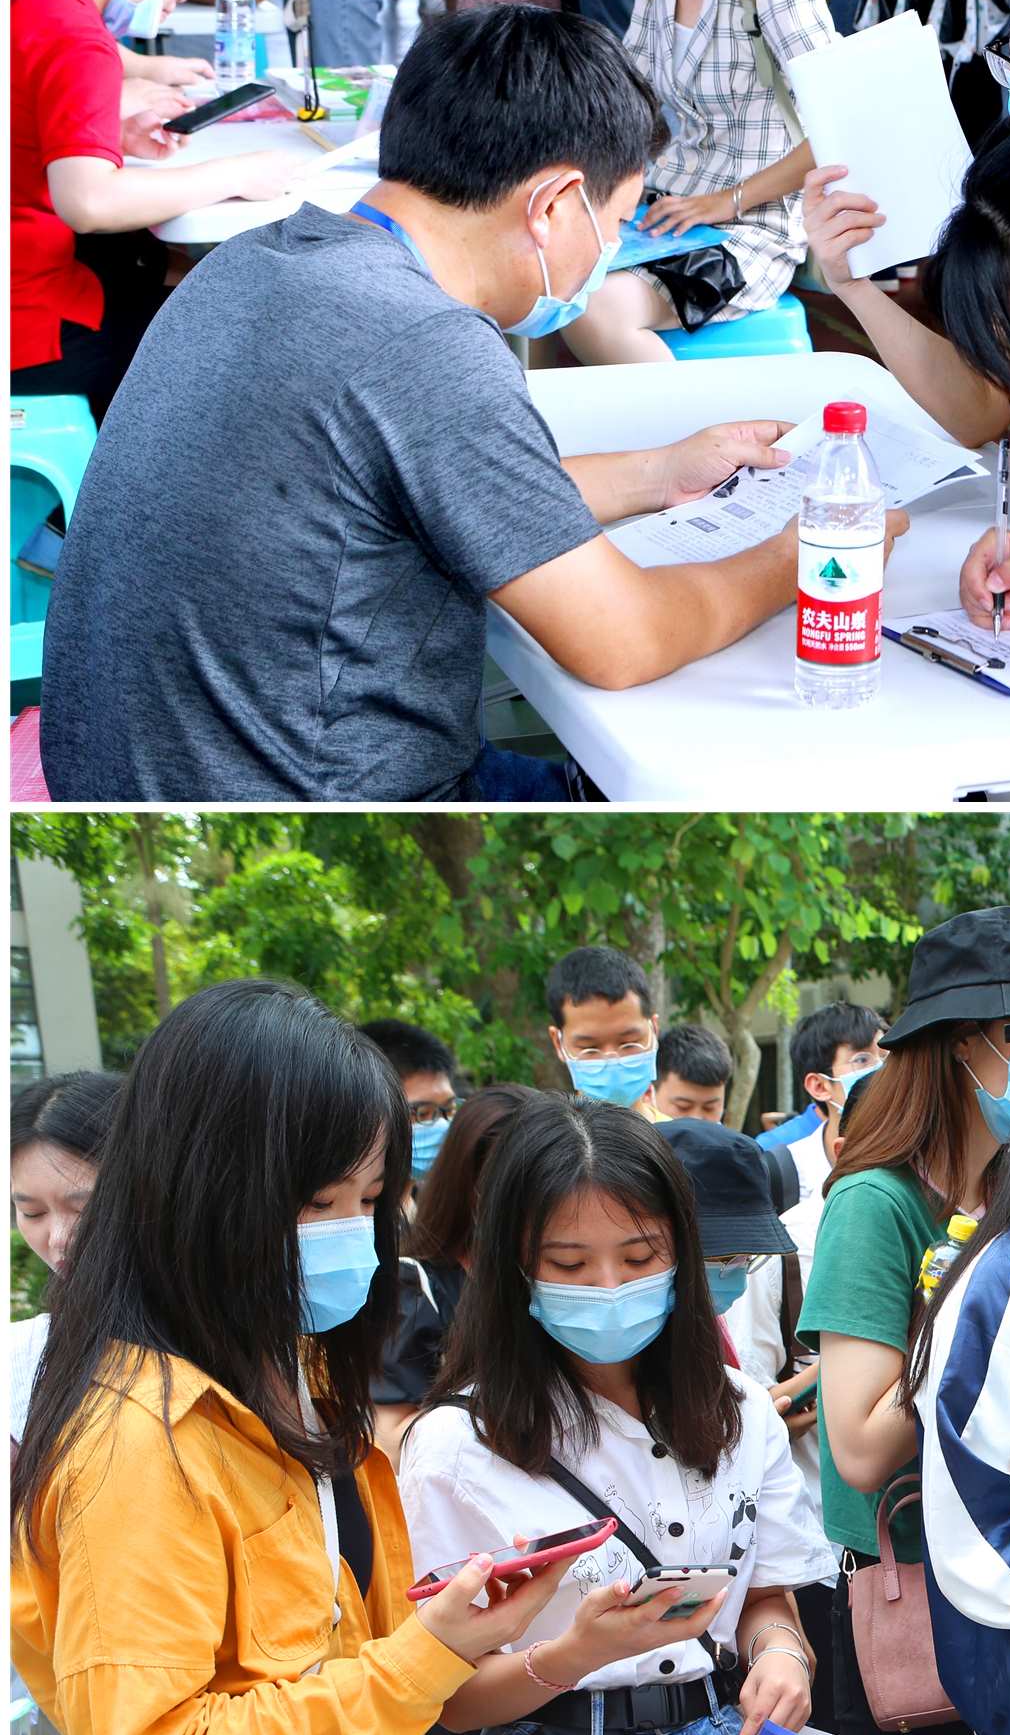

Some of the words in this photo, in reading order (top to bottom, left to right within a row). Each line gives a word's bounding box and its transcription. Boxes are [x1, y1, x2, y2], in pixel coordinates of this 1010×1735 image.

[802, 607, 866, 631] 农夫山泉
[802, 626, 832, 642] NONGFU
[834, 630, 866, 642] SPRING
